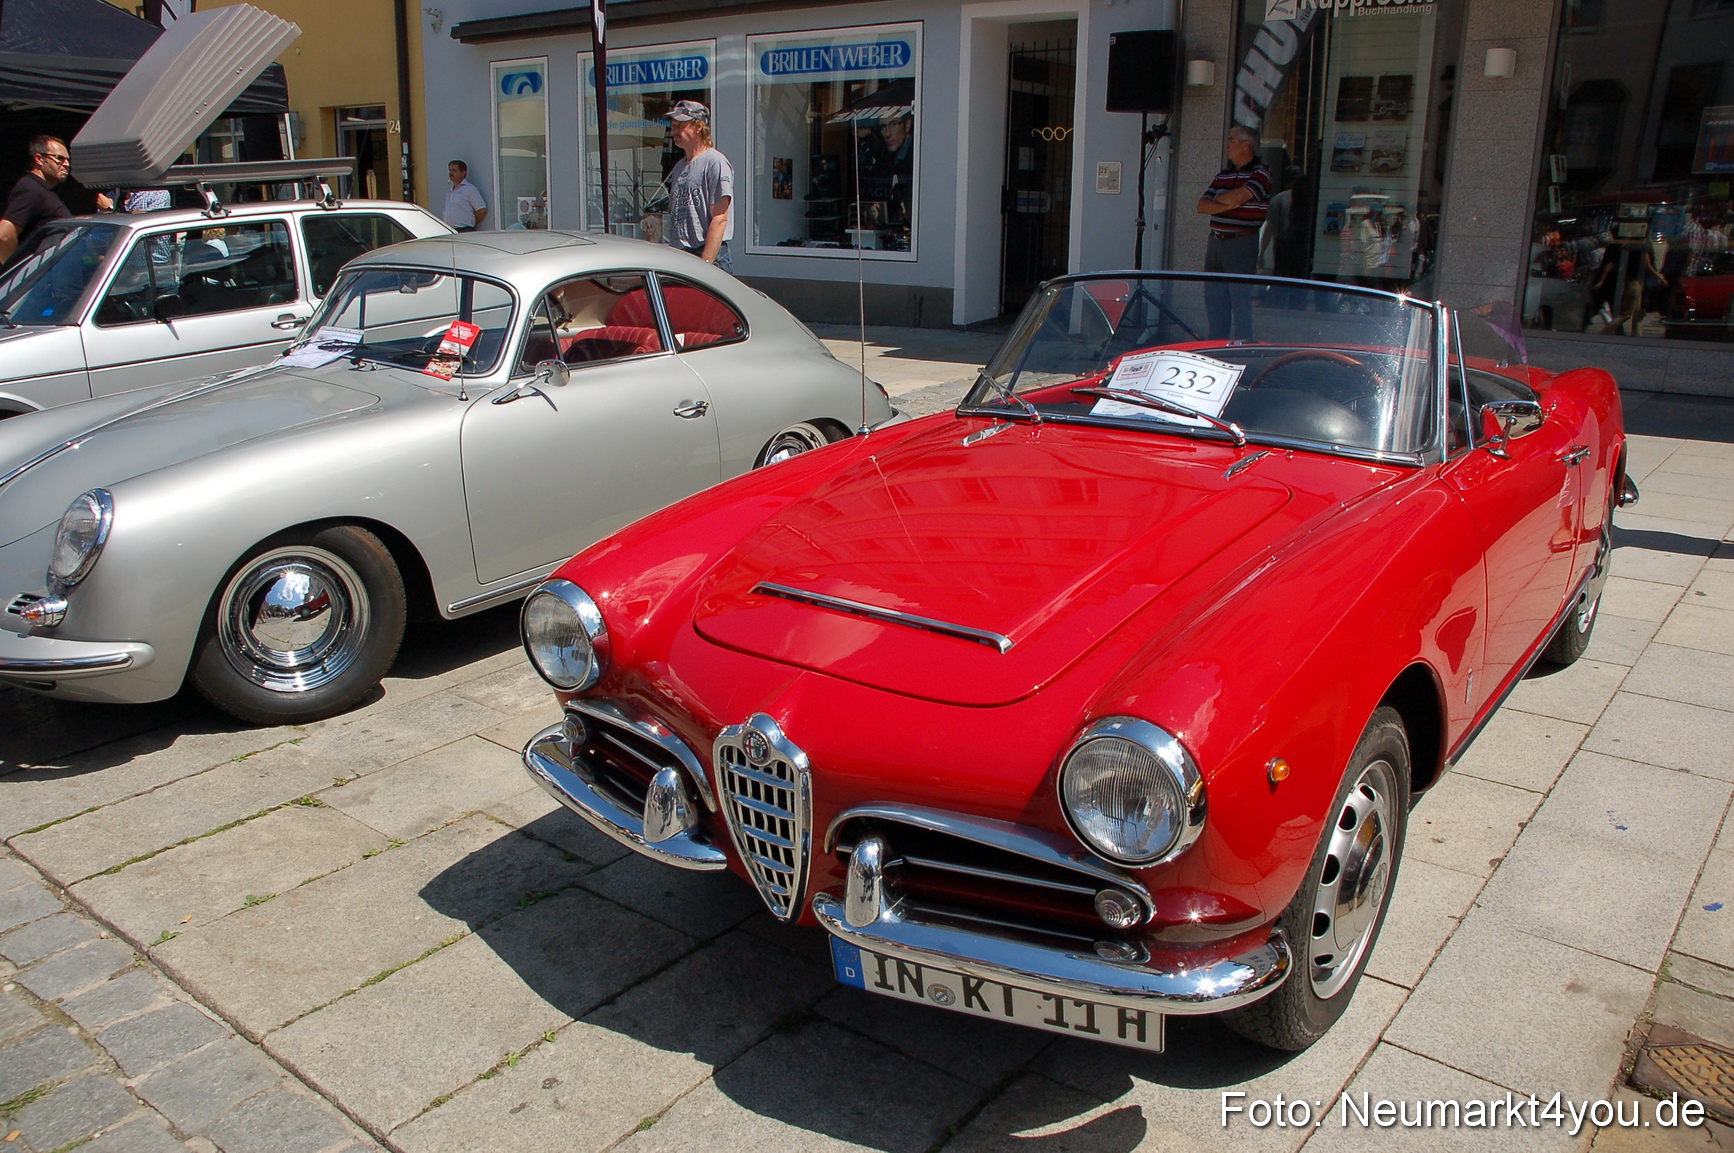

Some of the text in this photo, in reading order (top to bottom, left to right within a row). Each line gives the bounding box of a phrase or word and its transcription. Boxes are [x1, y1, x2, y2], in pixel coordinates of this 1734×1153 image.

[1358, 4, 1433, 16] Buchhandlung
[606, 58, 702, 84] RILLEN WEBER
[767, 43, 903, 73] BRILLEN WEBER
[389, 120, 401, 134] 24
[1160, 366, 1217, 395] 232
[845, 966, 856, 978] D
[873, 954, 924, 998] IN
